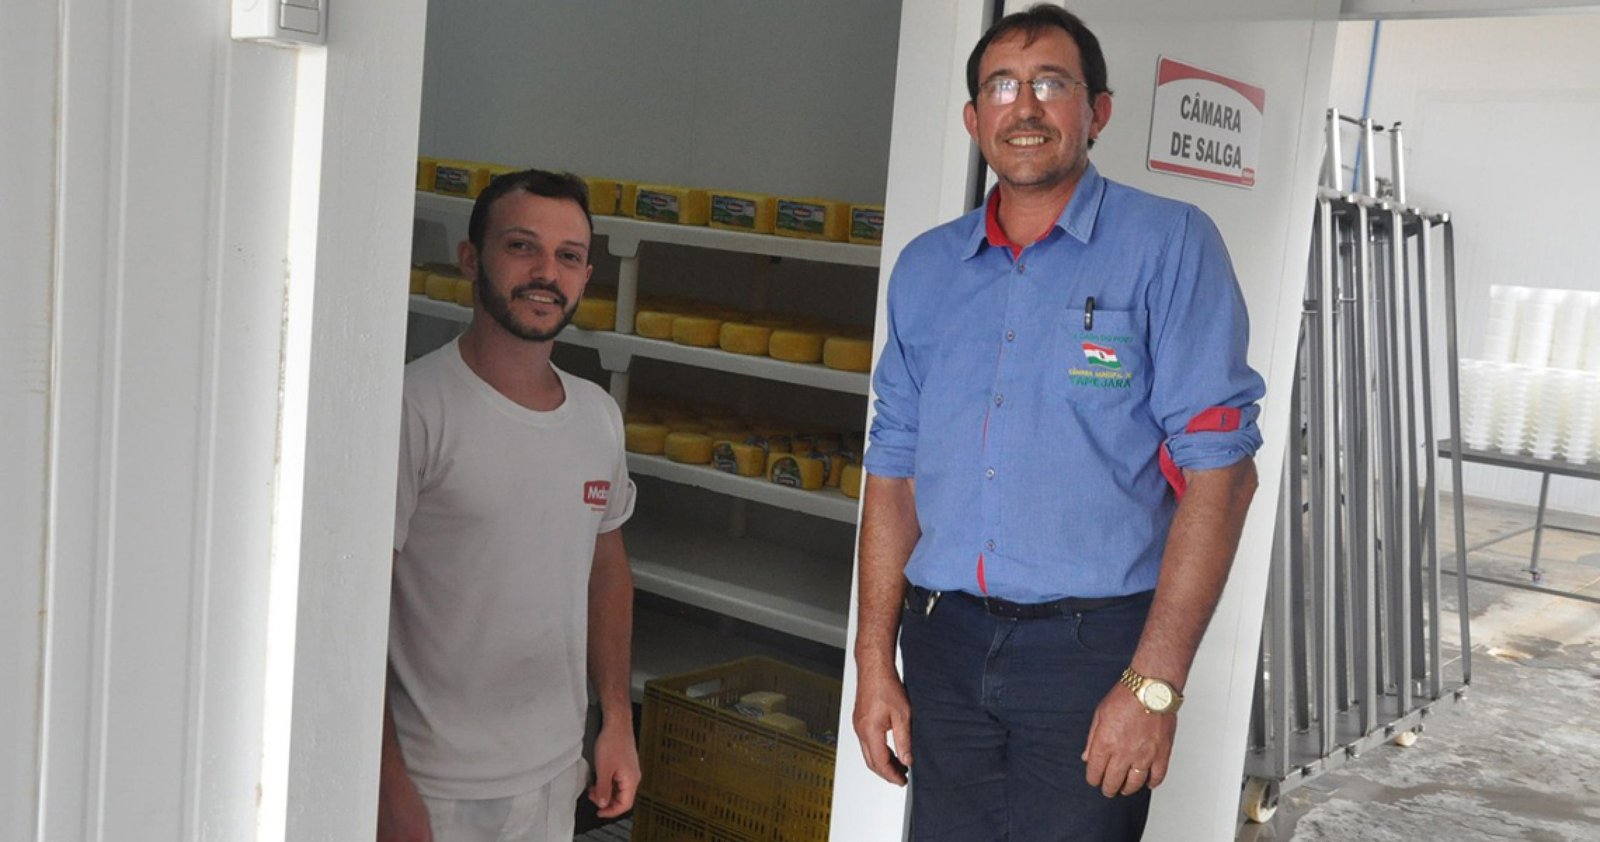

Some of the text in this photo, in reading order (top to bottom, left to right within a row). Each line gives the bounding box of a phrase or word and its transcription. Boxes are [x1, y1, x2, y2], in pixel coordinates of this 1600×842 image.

[1180, 91, 1241, 133] CÂMARA
[1170, 131, 1242, 169] DE SALGA
[1070, 376, 1131, 388] TAPEJARA
